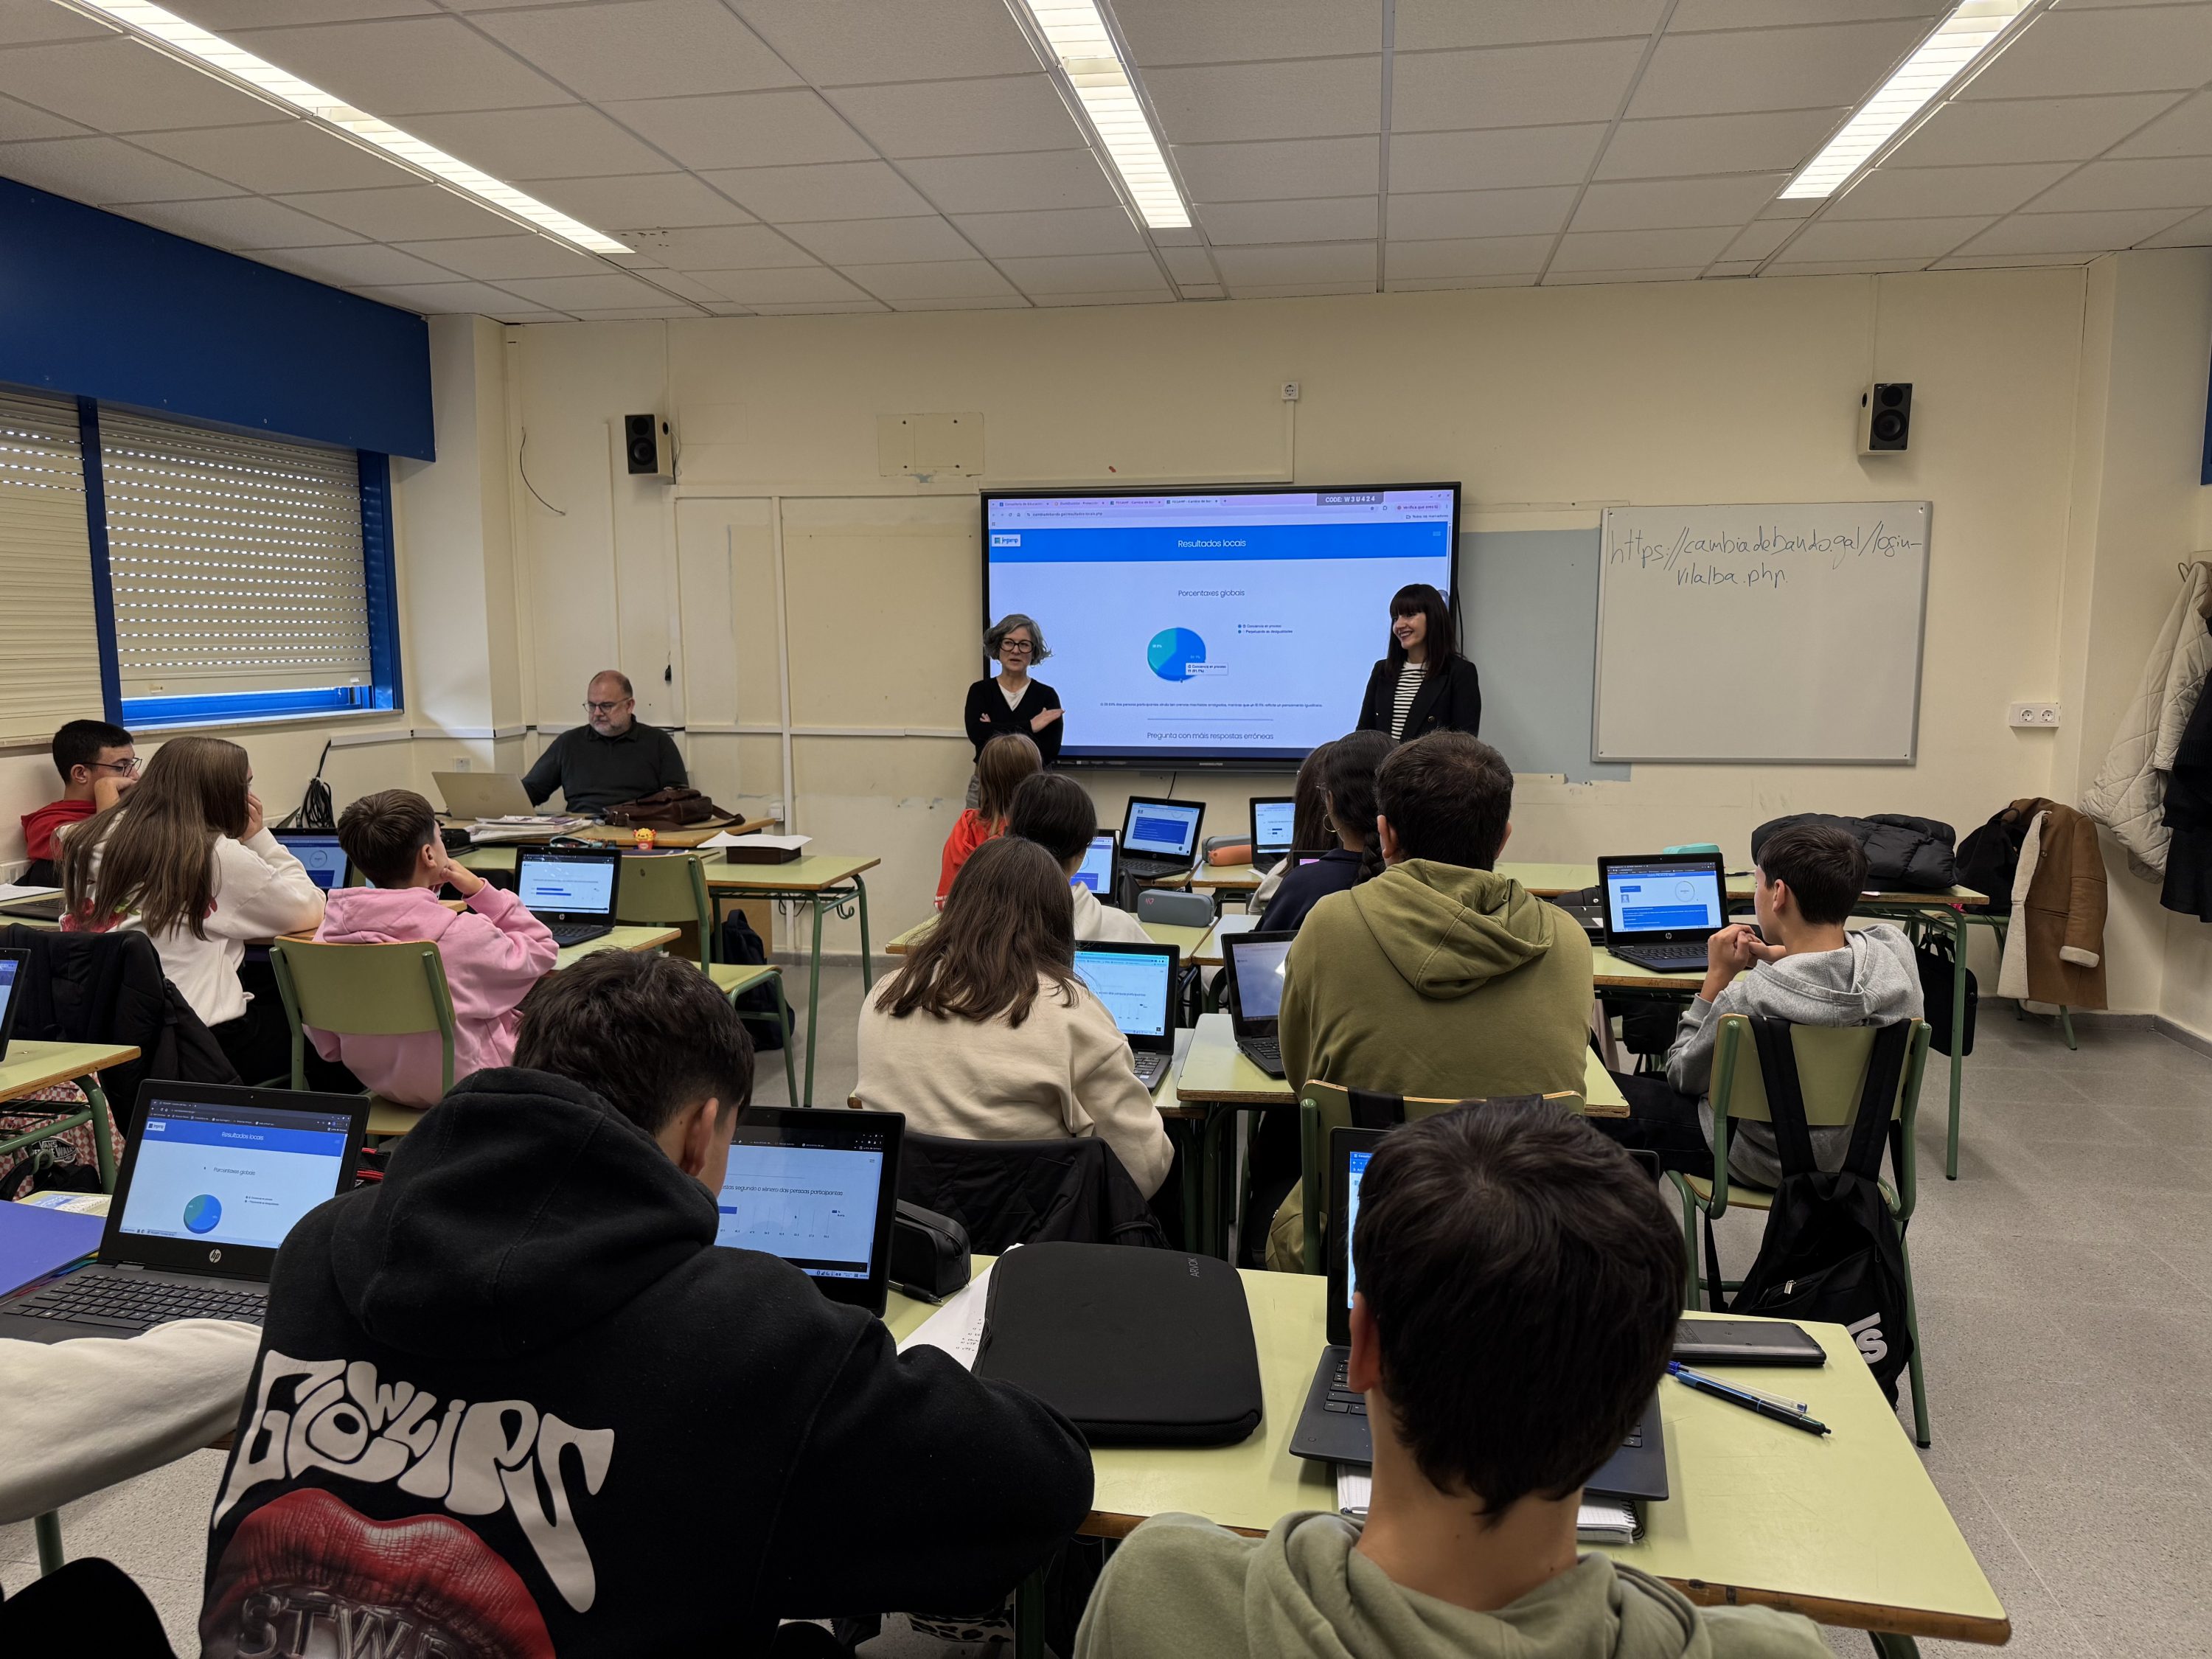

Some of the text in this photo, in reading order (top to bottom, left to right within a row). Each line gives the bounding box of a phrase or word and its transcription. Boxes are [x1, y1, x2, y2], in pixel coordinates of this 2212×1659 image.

[1222, 539, 1246, 547] locais
[1220, 589, 1245, 598] globais
[1147, 732, 1177, 740] Pregunta
[221, 1131, 248, 1139] Resultados
[38, 1140, 58, 1149] VANS
[214, 1166, 239, 1175] Porcentaxes
[209, 1248, 221, 1263] hp
[1187, 1257, 1200, 1277] ARVOK
